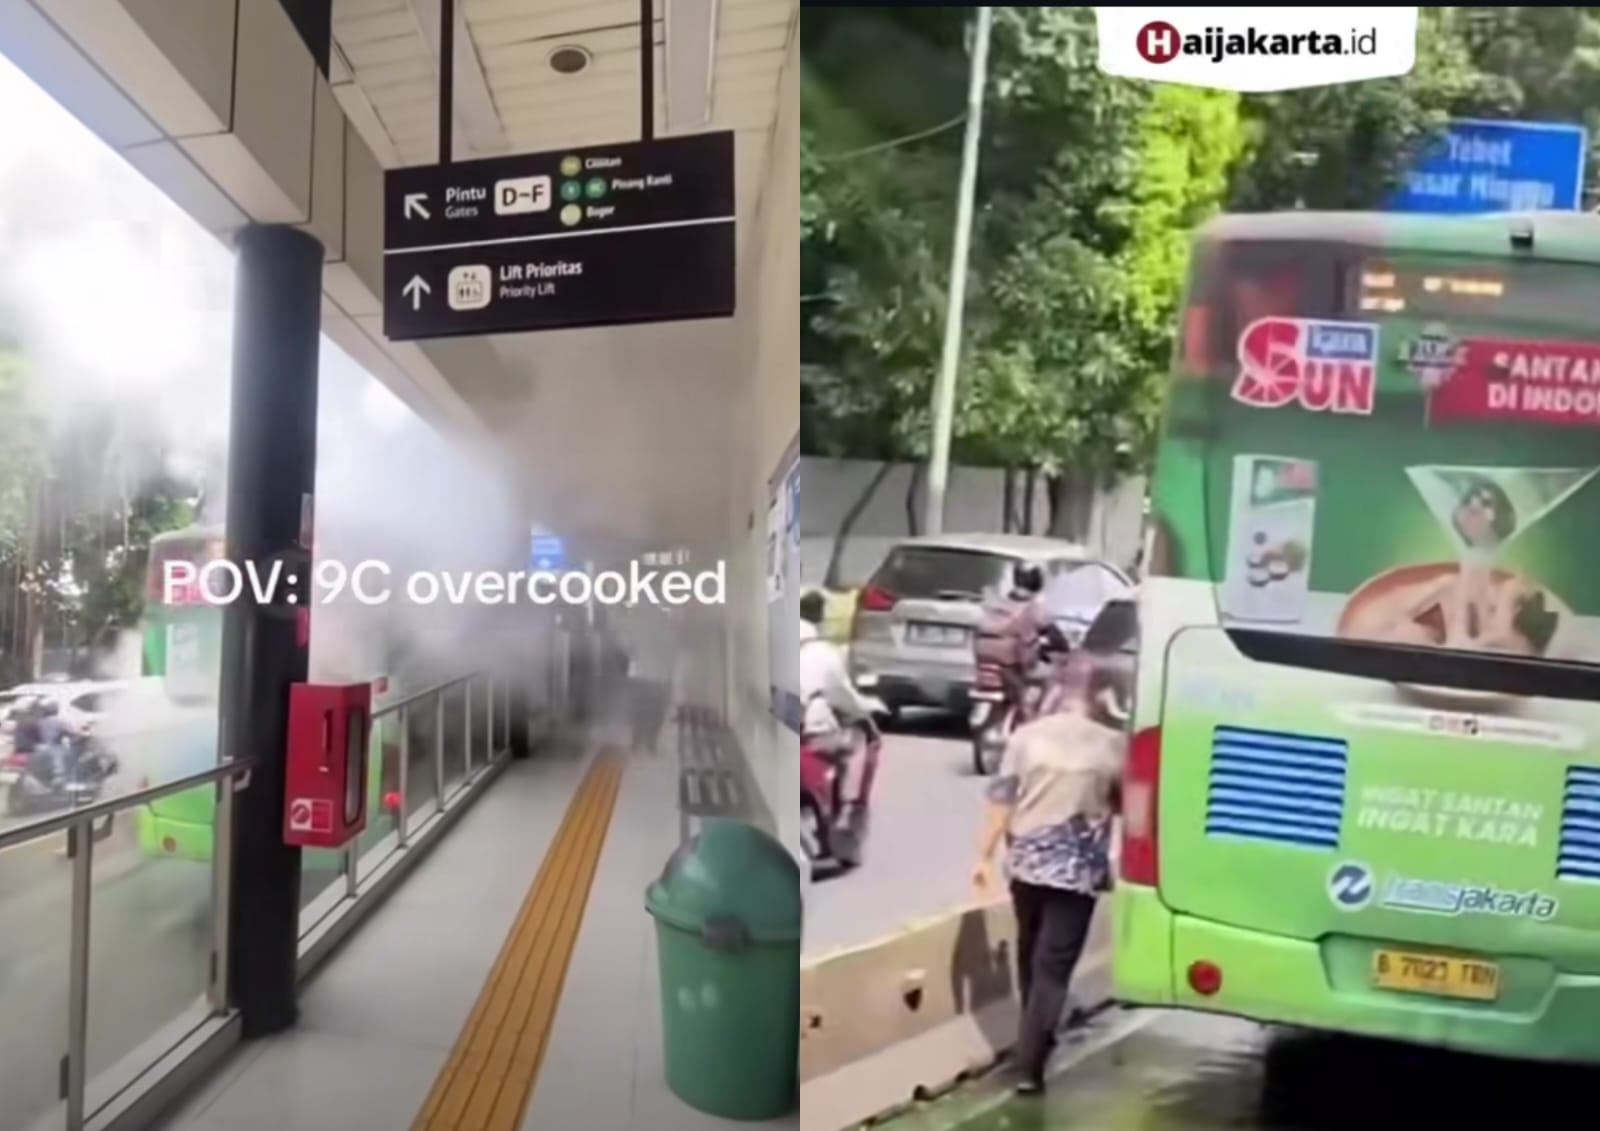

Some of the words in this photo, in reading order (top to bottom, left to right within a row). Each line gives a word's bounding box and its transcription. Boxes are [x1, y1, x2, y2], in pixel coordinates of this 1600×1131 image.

[445, 186, 487, 203] Pintu
[445, 205, 479, 219] Gates
[499, 265, 523, 281] Lift
[525, 261, 583, 279] Prioritas
[499, 285, 537, 299] Priority
[537, 283, 555, 296] Lift
[1487, 383, 1519, 409] DI
[1522, 384, 1600, 415] INDO
[1441, 791, 1544, 821] SANTAN
[1356, 806, 1449, 837] INGAT
[1456, 817, 1539, 847] KARA
